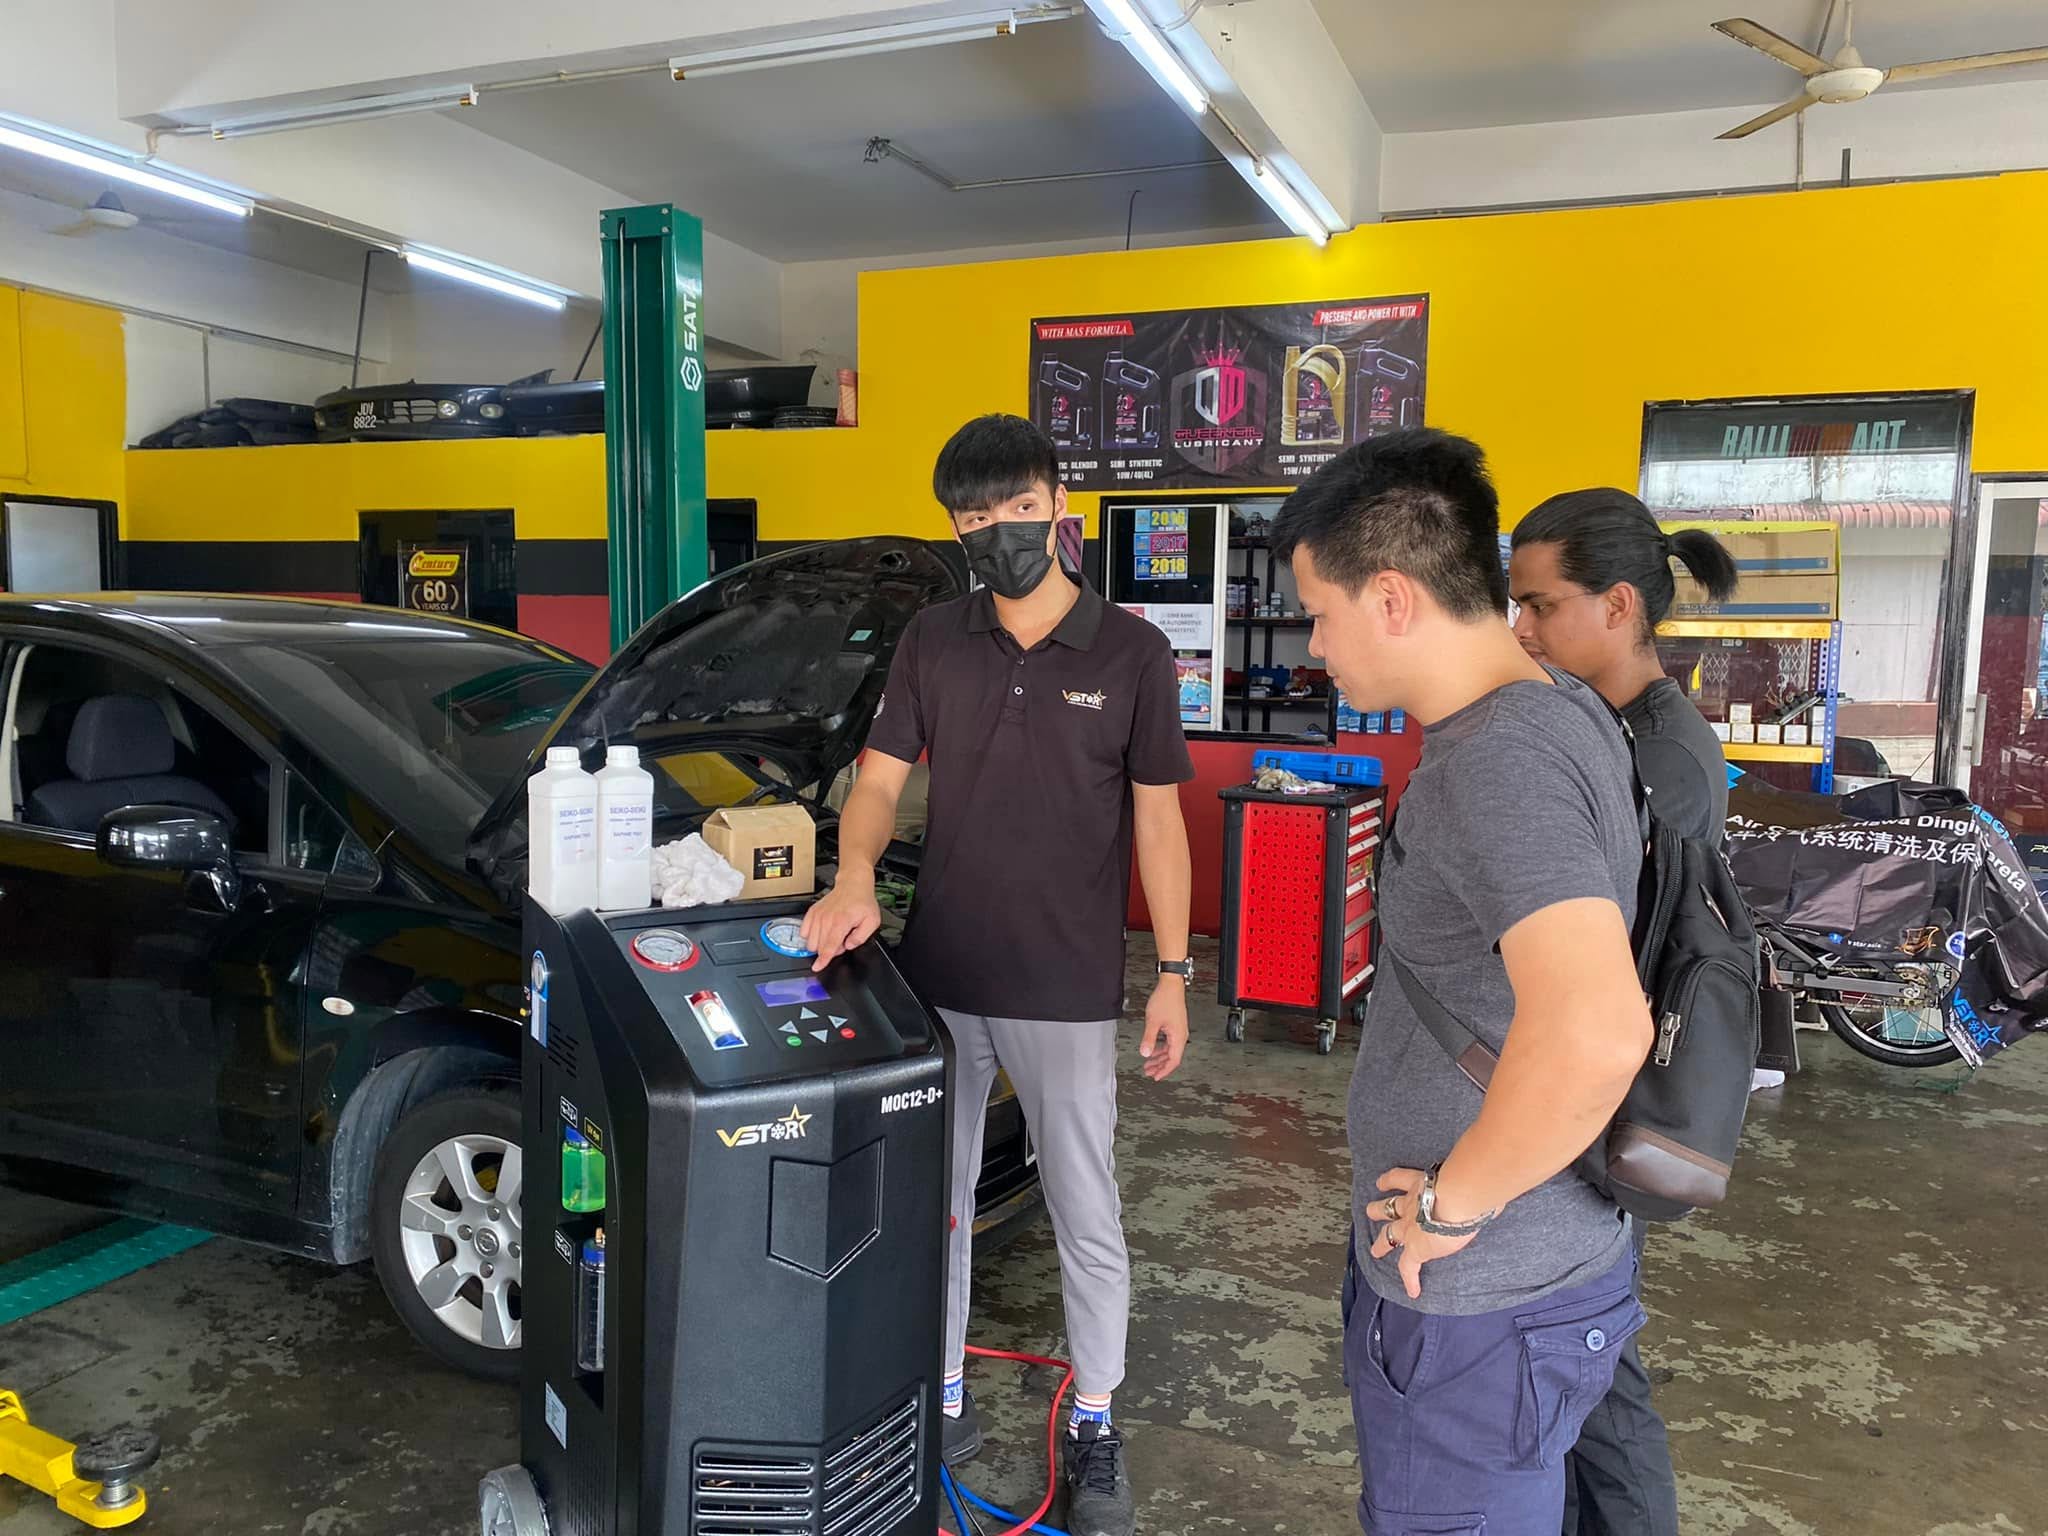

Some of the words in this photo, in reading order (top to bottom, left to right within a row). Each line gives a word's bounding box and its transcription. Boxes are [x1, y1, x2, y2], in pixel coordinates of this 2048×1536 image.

[1320, 311, 1353, 324] PRESERVE
[1353, 309, 1367, 321] AND
[1368, 307, 1390, 320] POWER
[1391, 306, 1399, 319] IT
[1399, 305, 1417, 318] WITH
[1041, 328, 1064, 339] WITH
[1064, 327, 1084, 337] MAS
[1084, 325, 1127, 336] FORMULA
[353, 415, 377, 429] 8822
[1174, 438, 1263, 448] LUBRICANT
[1720, 425, 1790, 457] RALLI
[1851, 420, 1906, 453] ART
[1070, 460, 1098, 470] BLENDED
[1110, 460, 1126, 469] SEMI
[1129, 459, 1163, 468] SYNTHETIC
[1278, 455, 1296, 464] SEMI
[1151, 536, 1186, 549] 2017
[1150, 558, 1186, 574] 2018
[423, 580, 447, 602] 60
[422, 603, 440, 611] YEARS
[440, 603, 449, 611] OF
[880, 1086, 944, 1114] MOC12-D+
